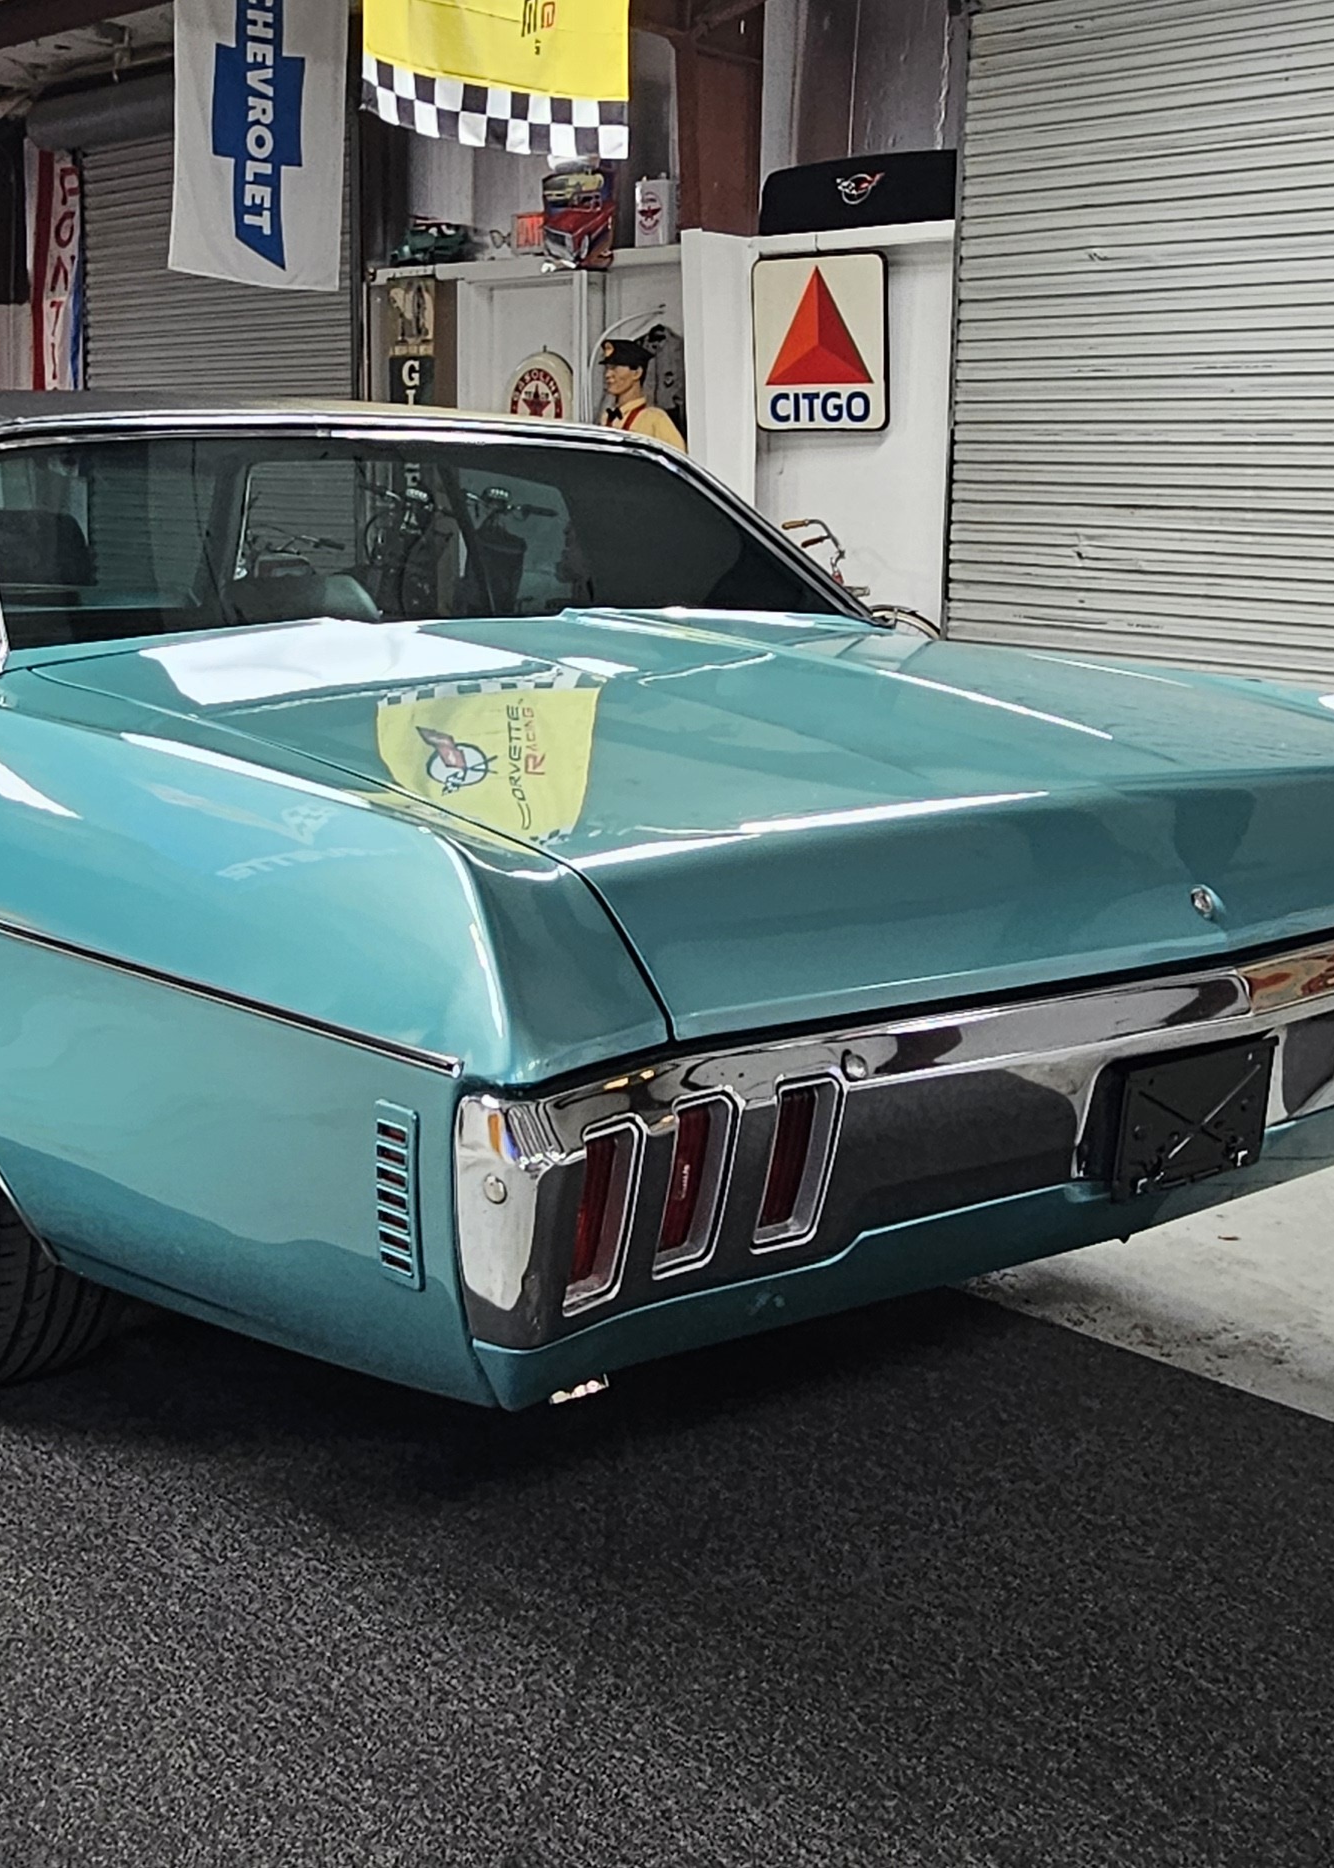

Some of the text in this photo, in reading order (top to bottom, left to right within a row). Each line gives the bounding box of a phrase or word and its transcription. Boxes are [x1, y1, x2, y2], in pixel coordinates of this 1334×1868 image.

[243, 0, 274, 236] HEVROLET
[770, 391, 871, 422] CITGO
[507, 704, 532, 831] CORVETTE
[522, 706, 547, 776] RACING
